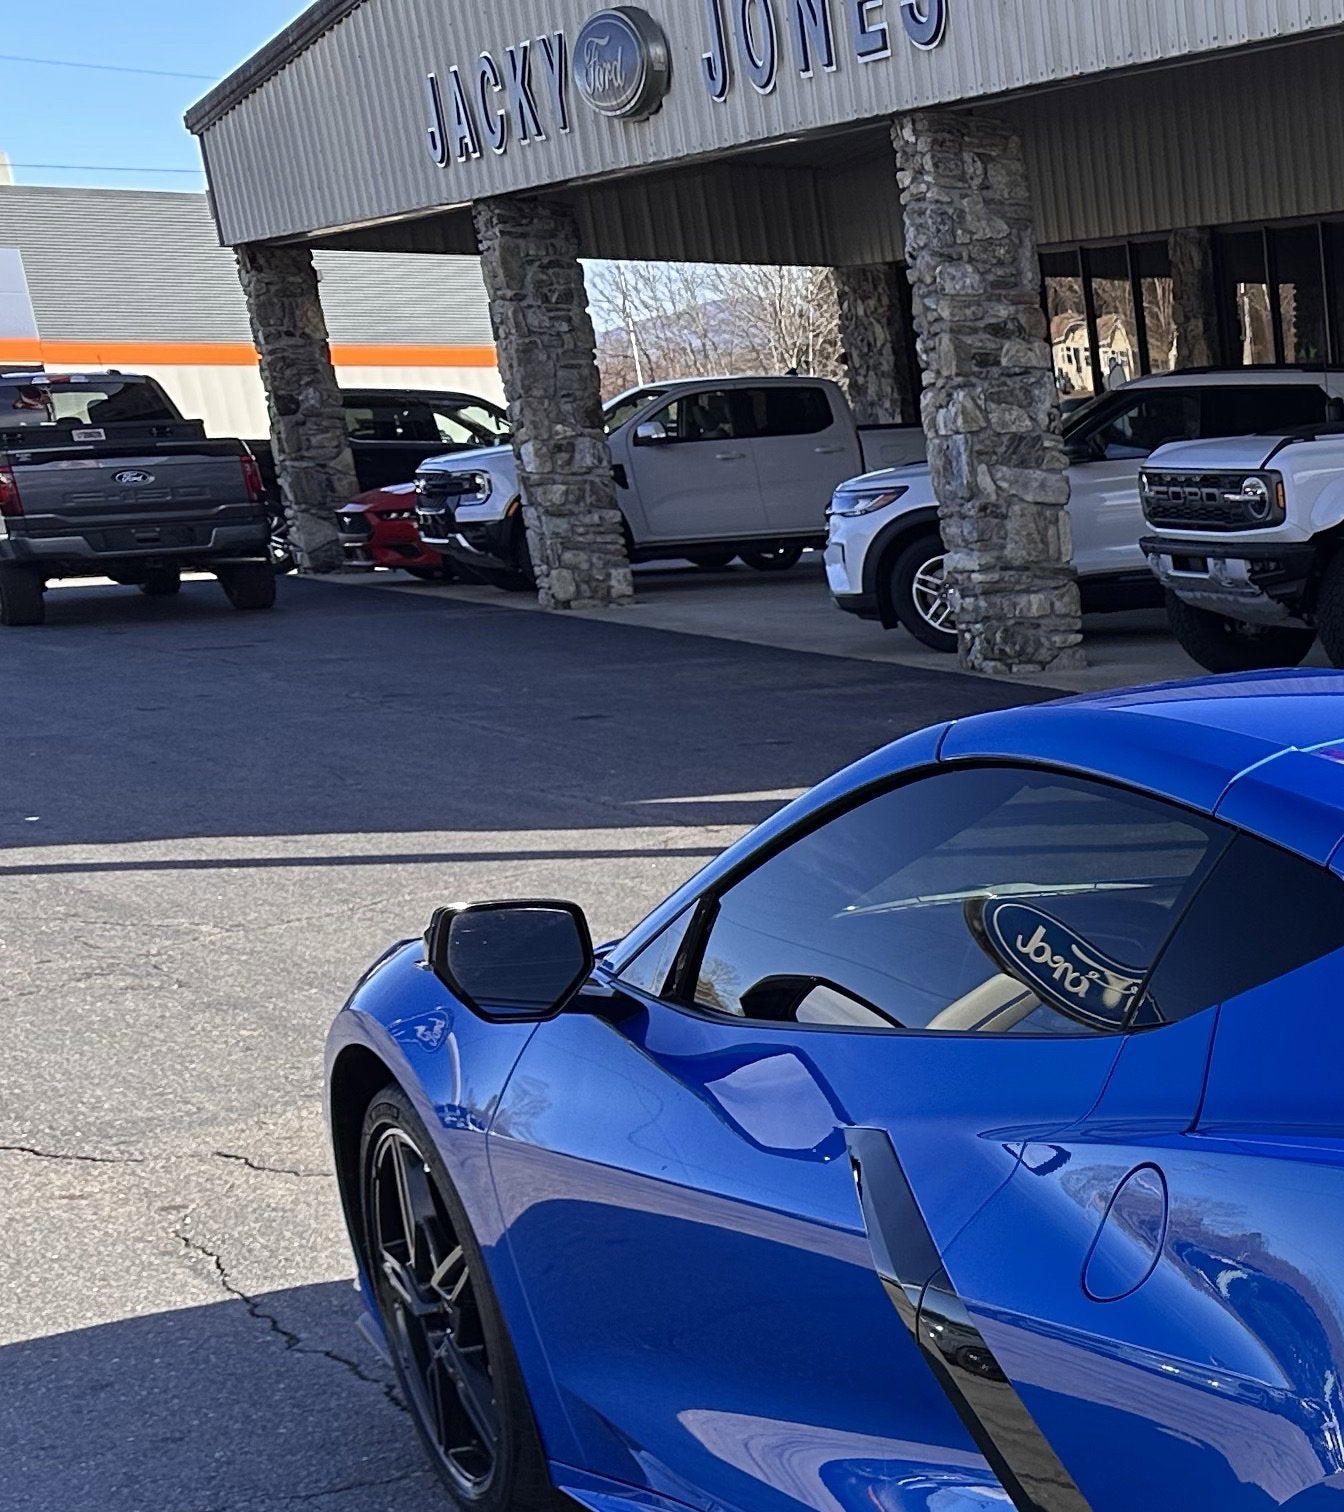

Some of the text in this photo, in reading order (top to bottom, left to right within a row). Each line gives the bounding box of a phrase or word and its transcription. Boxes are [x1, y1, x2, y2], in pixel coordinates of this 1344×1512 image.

[427, 29, 570, 168] JACKY
[583, 34, 626, 96] Ford
[1151, 485, 1221, 504] FORD
